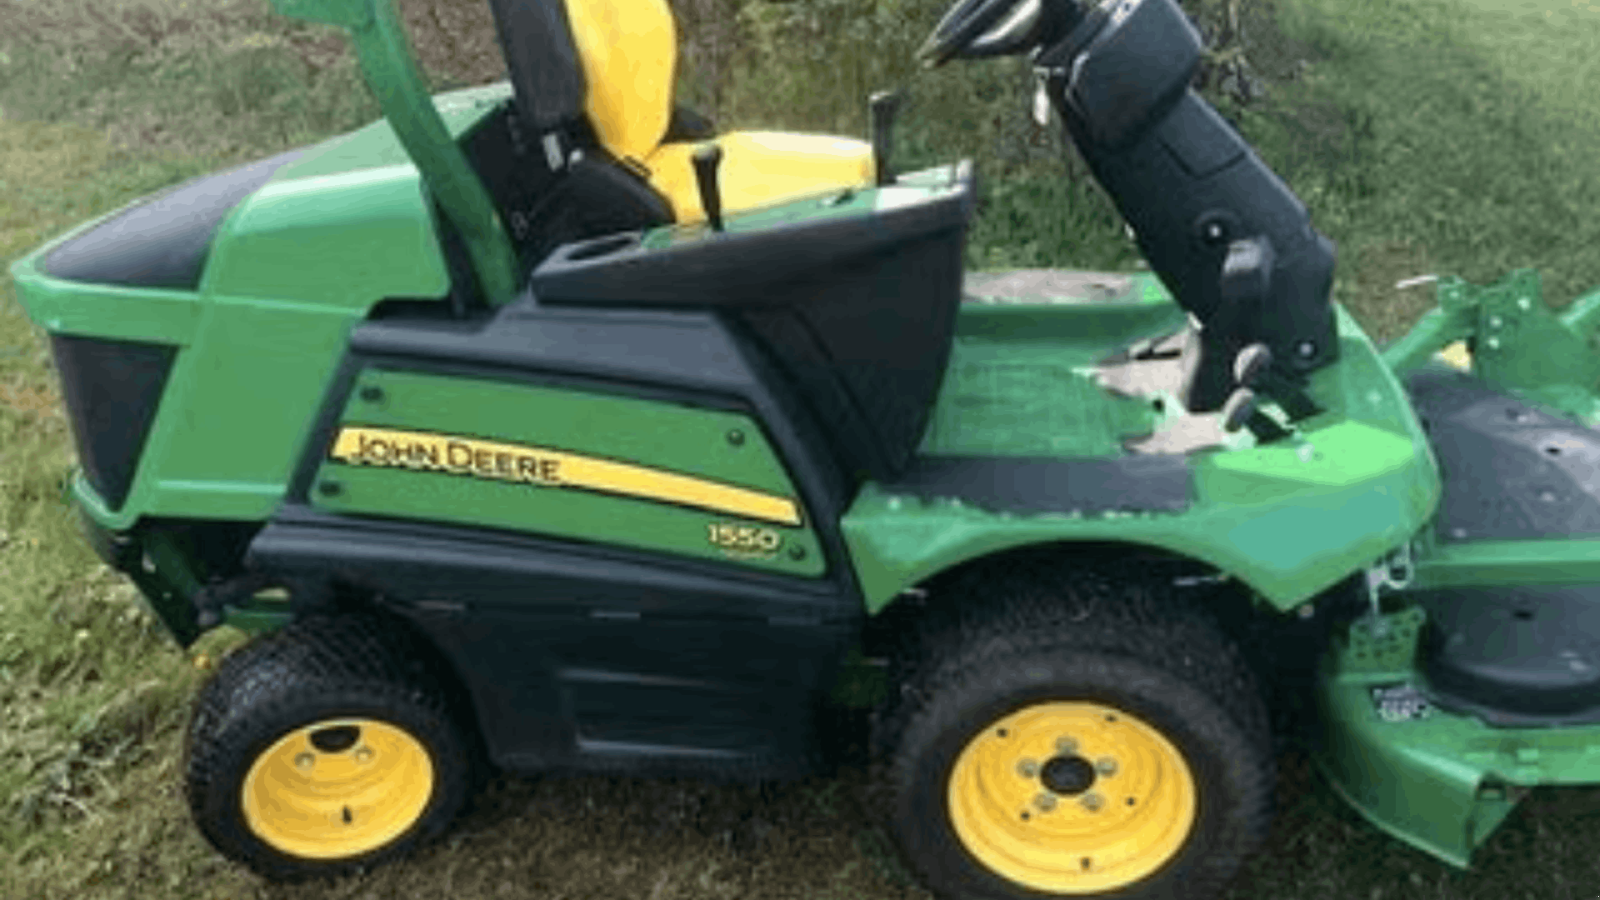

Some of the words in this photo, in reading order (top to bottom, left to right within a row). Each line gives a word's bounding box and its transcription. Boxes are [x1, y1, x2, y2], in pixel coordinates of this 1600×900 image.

[350, 432, 440, 467] JOHN
[446, 440, 562, 482] DEERE
[708, 523, 781, 551] 1550
